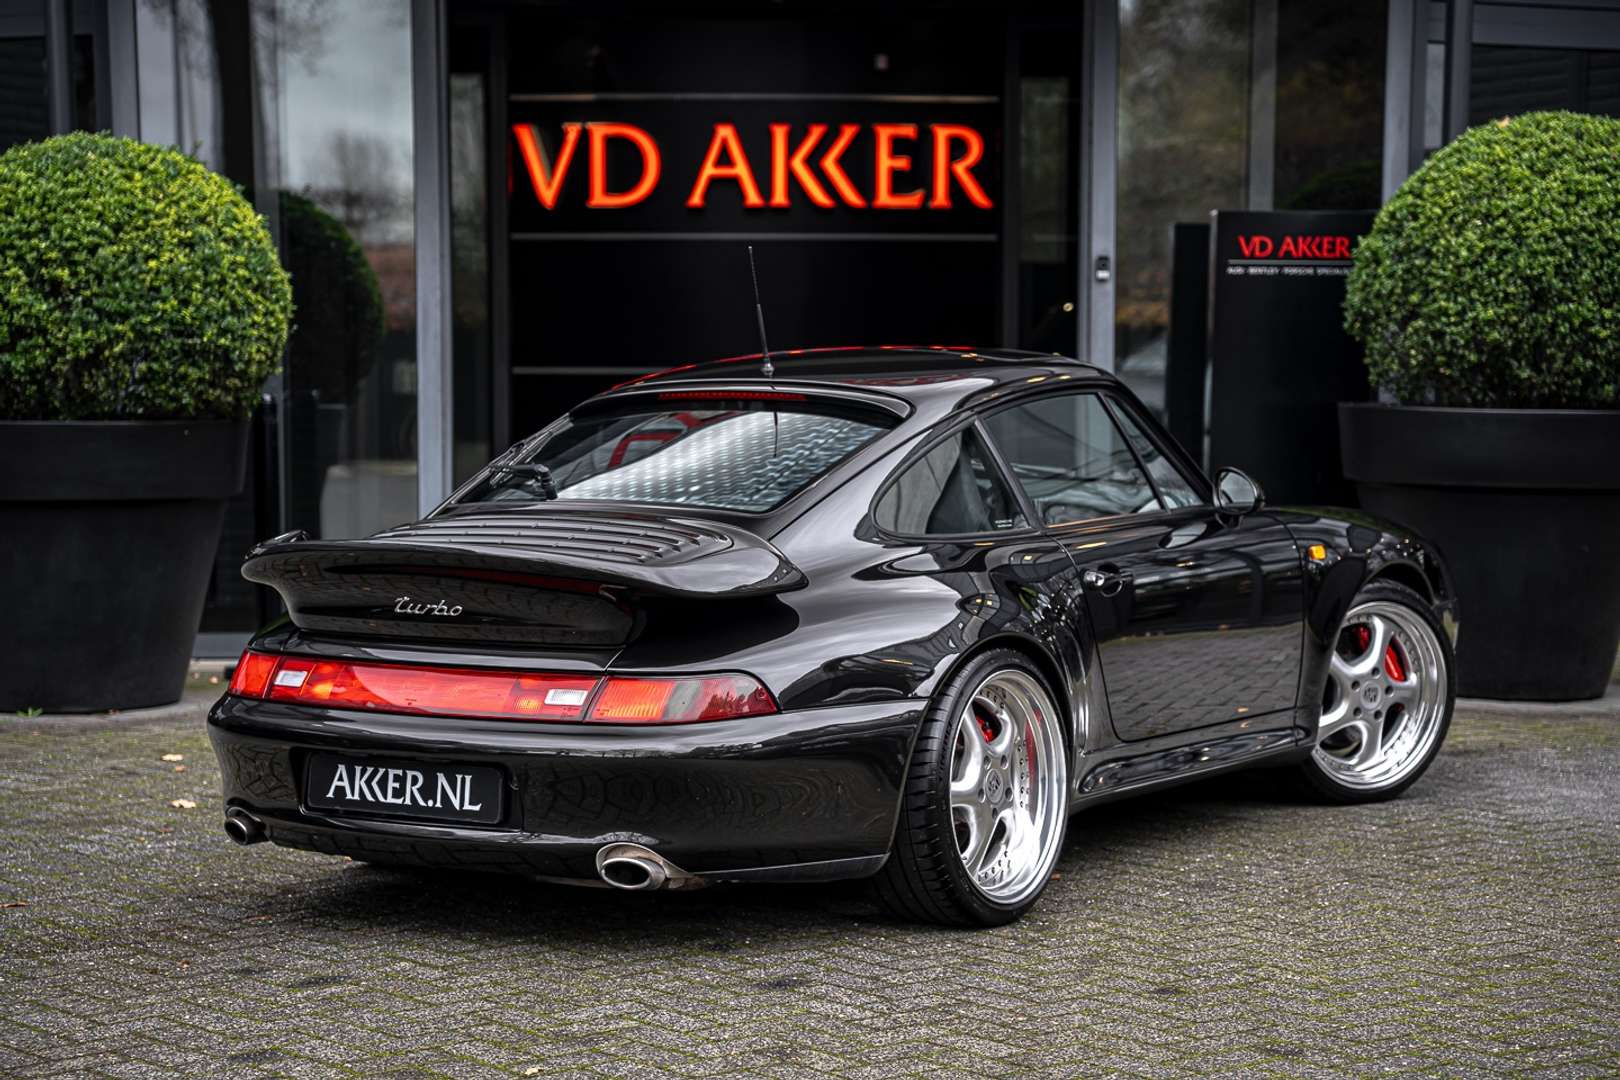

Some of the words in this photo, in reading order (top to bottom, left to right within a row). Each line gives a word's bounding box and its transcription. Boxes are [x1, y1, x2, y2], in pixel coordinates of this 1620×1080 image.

[511, 122, 662, 210] VD
[685, 122, 994, 210] AKKER
[1237, 235, 1274, 258] VD
[1277, 235, 1352, 259] AKKER
[394, 596, 463, 616] Turbo
[325, 764, 482, 811] AKKER.NL
